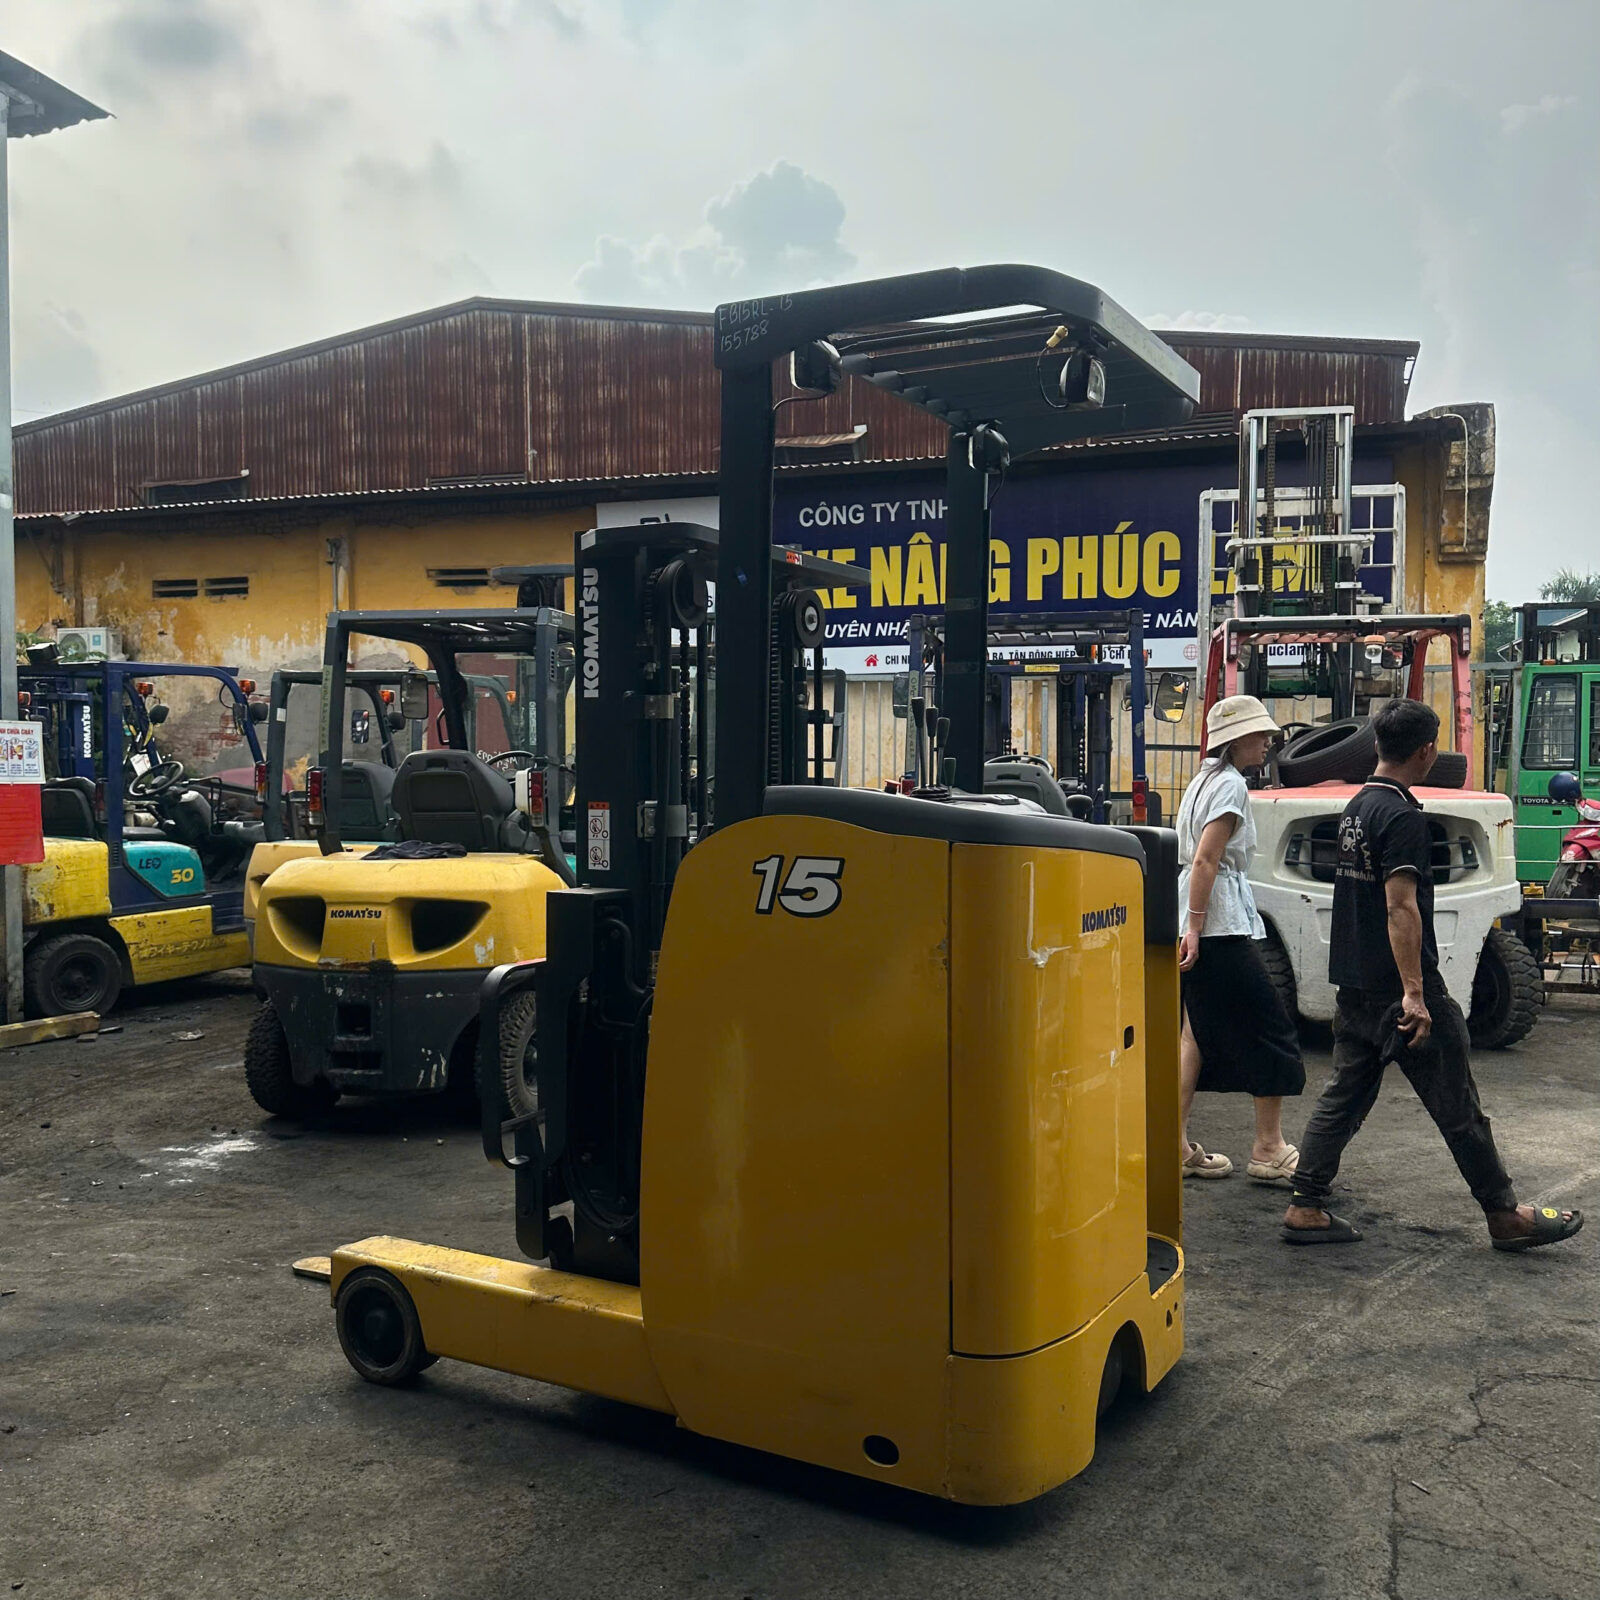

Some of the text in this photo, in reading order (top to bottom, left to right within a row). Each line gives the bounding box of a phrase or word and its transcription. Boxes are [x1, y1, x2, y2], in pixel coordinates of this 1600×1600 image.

[720, 319, 769, 352] 155788
[799, 499, 948, 527] CÔNG TY TNH
[870, 531, 1011, 608] NÂG
[1027, 521, 1181, 601] PHÚC
[579, 567, 600, 698] KOMATSU
[824, 620, 871, 638] UYÊN
[875, 620, 911, 639] NHẬ
[1155, 608, 1198, 628] NÂN
[885, 655, 900, 665] CHI
[81, 705, 92, 758] KOMATSU
[170, 867, 194, 884] 30
[752, 854, 845, 918] 15
[330, 907, 382, 919] KOMATSU
[1082, 902, 1127, 934] KOMATSU
